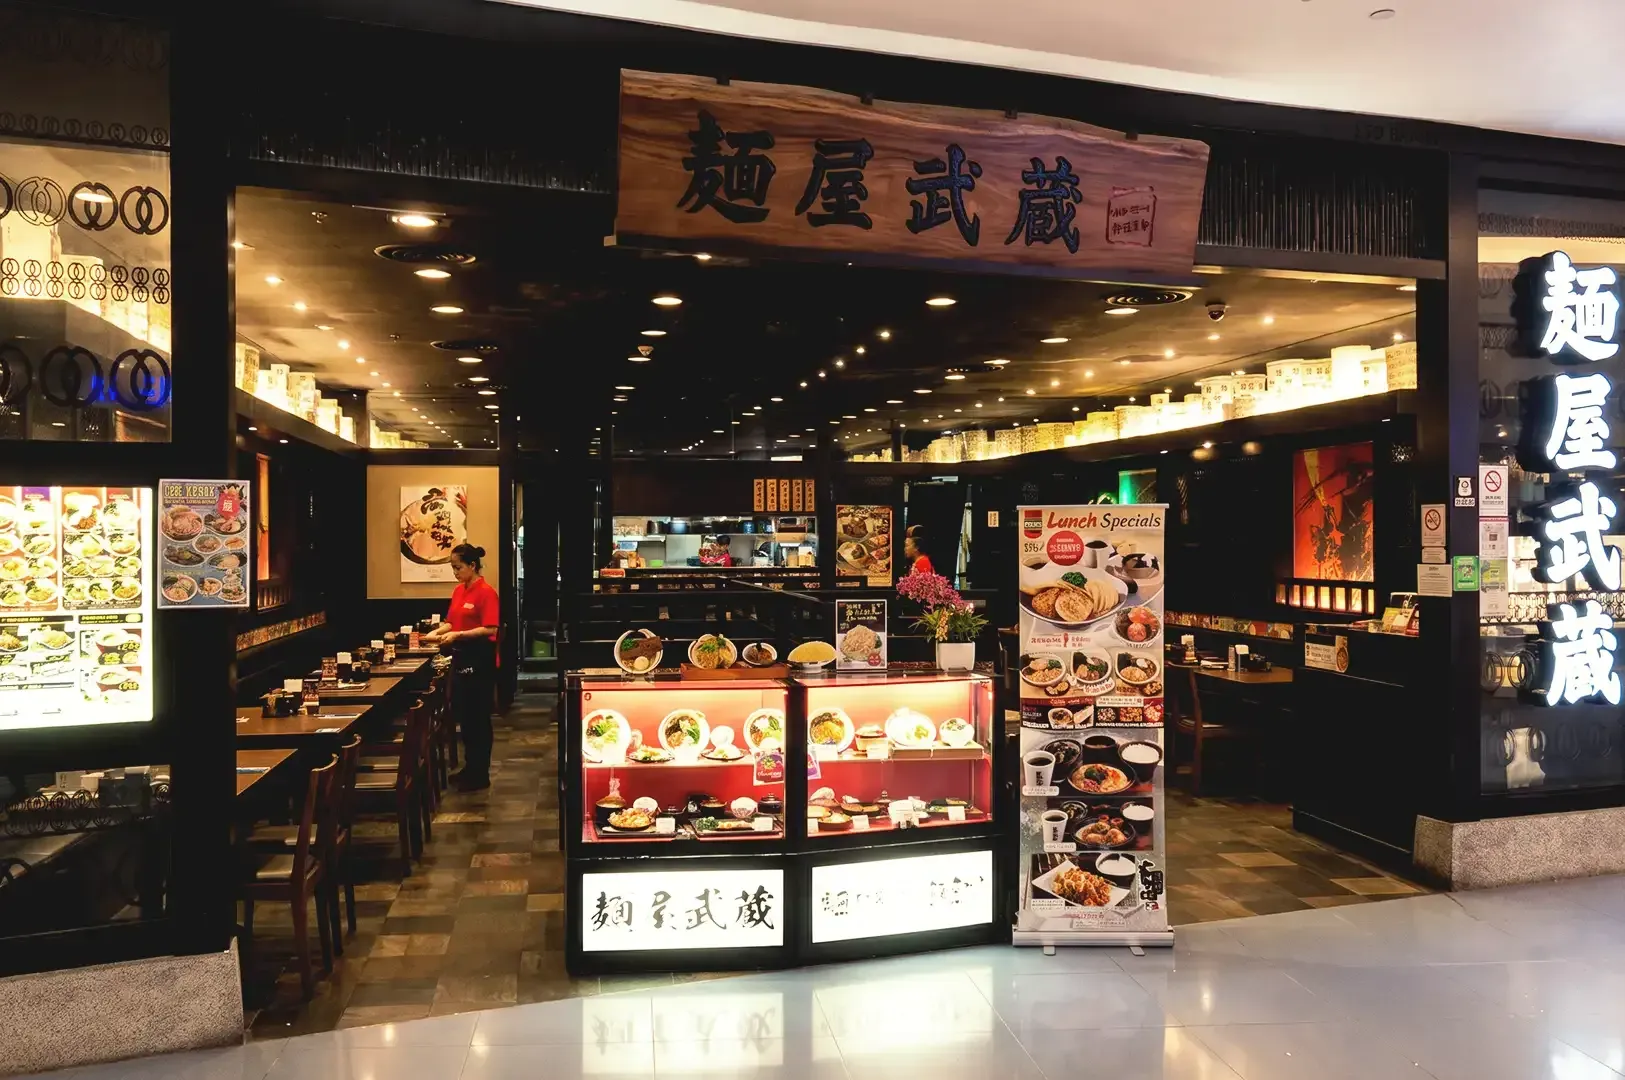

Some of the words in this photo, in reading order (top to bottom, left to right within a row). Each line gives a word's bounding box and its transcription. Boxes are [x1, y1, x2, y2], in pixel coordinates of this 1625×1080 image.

[676, 109, 1083, 254] 麺屋武蔵
[1046, 511, 1097, 529] Lunch
[1100, 512, 1161, 531] Specials
[1540, 251, 1620, 707] 麺屋武蔵
